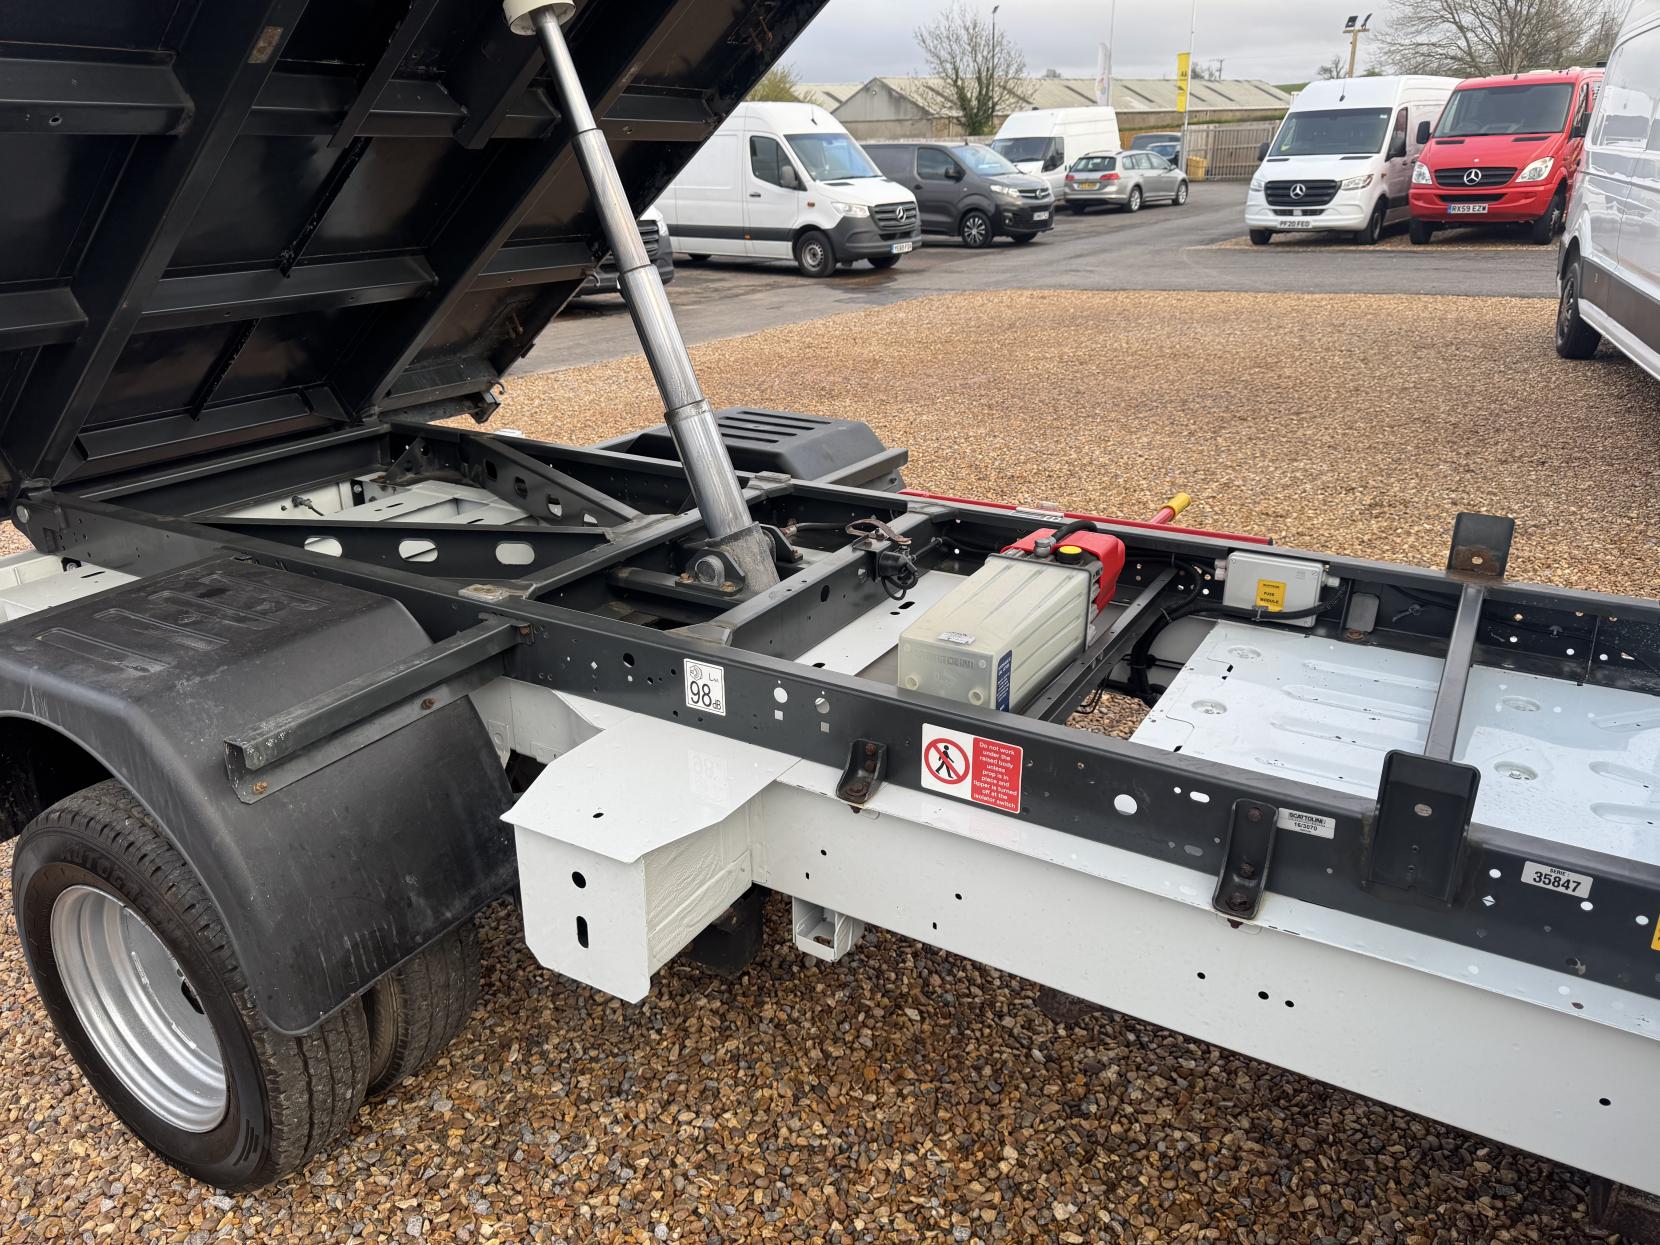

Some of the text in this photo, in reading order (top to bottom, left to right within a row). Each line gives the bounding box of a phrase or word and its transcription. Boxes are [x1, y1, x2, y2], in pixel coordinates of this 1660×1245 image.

[1453, 204, 1471, 212] RX59
[690, 681, 712, 707] 98
[1000, 748, 1014, 756] work
[980, 756, 1014, 768] raised body
[986, 764, 1006, 772] unless
[982, 770, 996, 778] prop
[974, 780, 990, 788] tipper
[998, 786, 1016, 796] turned
[974, 794, 1016, 808] isolator switch
[1294, 822, 1318, 832] 16/3070
[1550, 868, 1566, 876] SERIE
[1533, 871, 1582, 892] 35847
